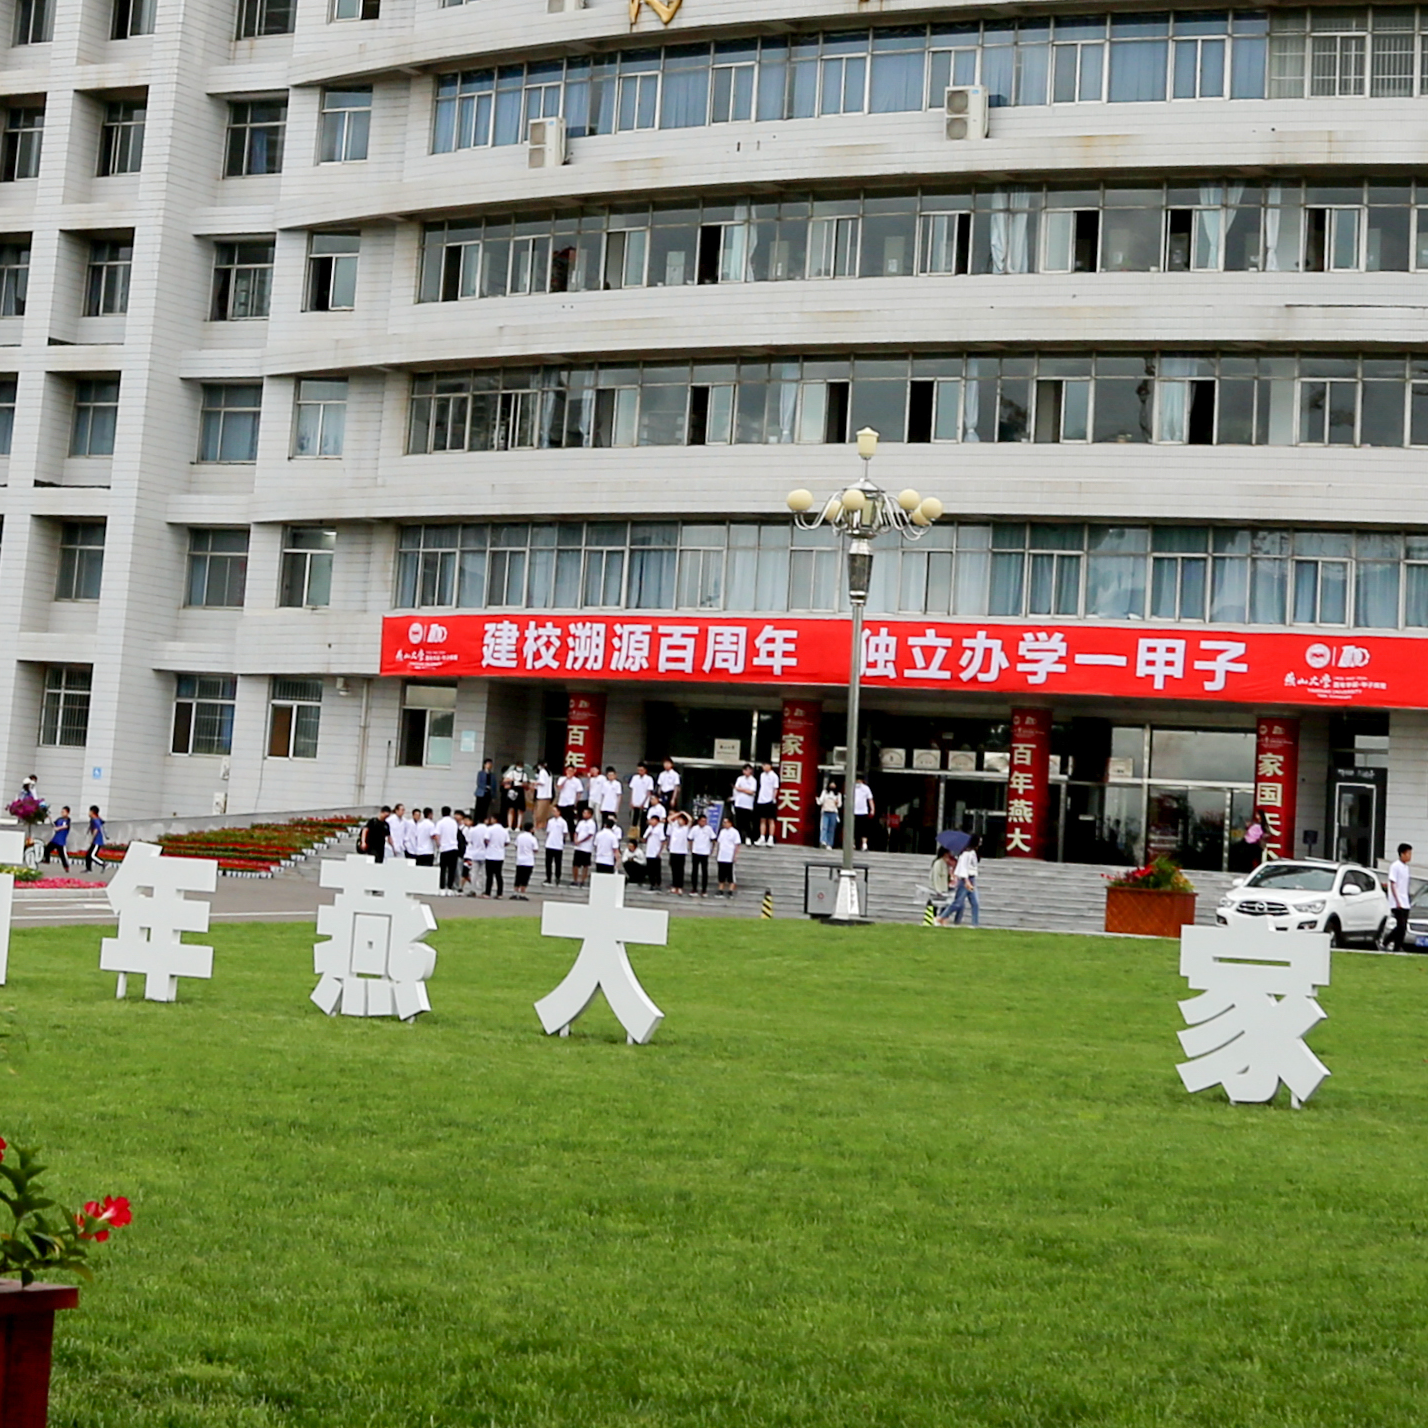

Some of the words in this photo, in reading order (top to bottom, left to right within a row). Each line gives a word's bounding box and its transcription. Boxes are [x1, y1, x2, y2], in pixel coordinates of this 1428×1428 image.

[481, 620, 800, 675] 建校溯源百周年
[860, 627, 1249, 692] 独立办学一甲子
[775, 733, 804, 840] 家国天下
[1006, 743, 1037, 853] 百年燕大
